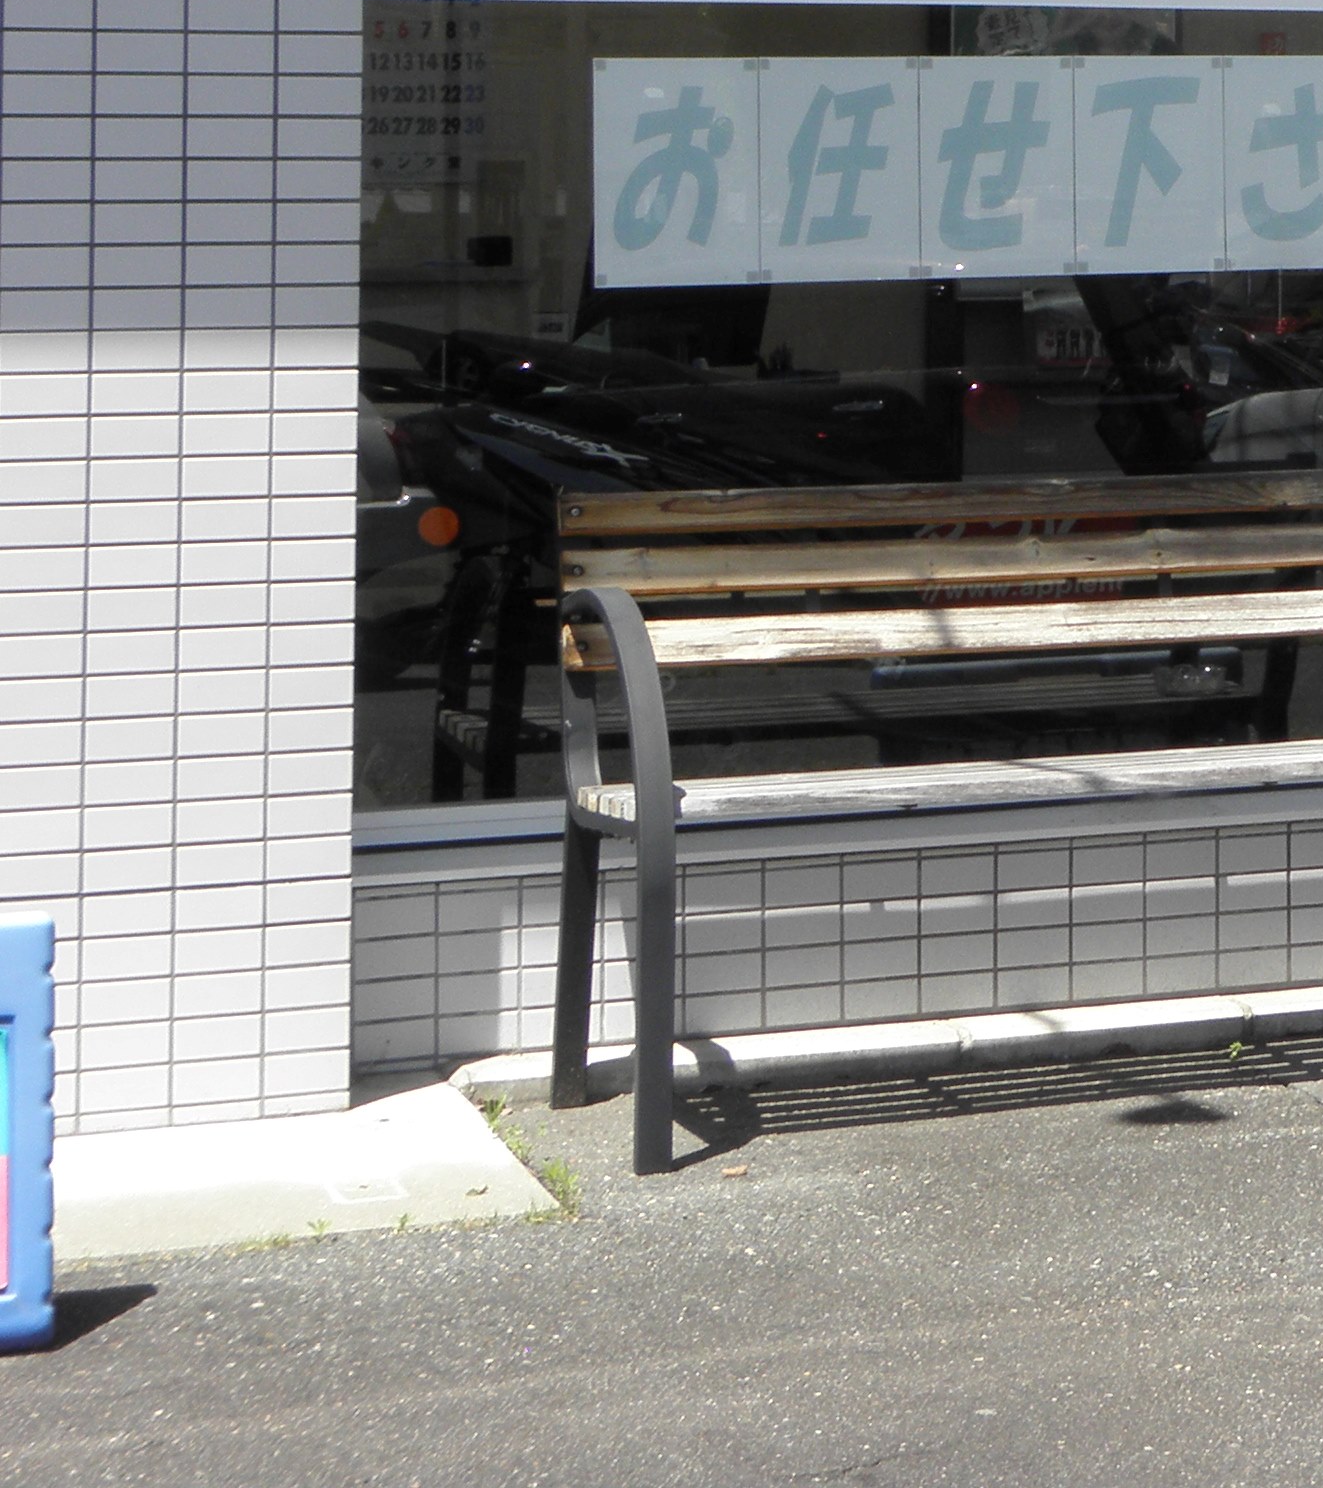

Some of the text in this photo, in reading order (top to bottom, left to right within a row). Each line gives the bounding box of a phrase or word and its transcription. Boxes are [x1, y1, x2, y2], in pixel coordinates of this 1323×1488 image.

[442, 53, 462, 71] 15
[440, 85, 461, 103] 22
[440, 117, 461, 135] 29
